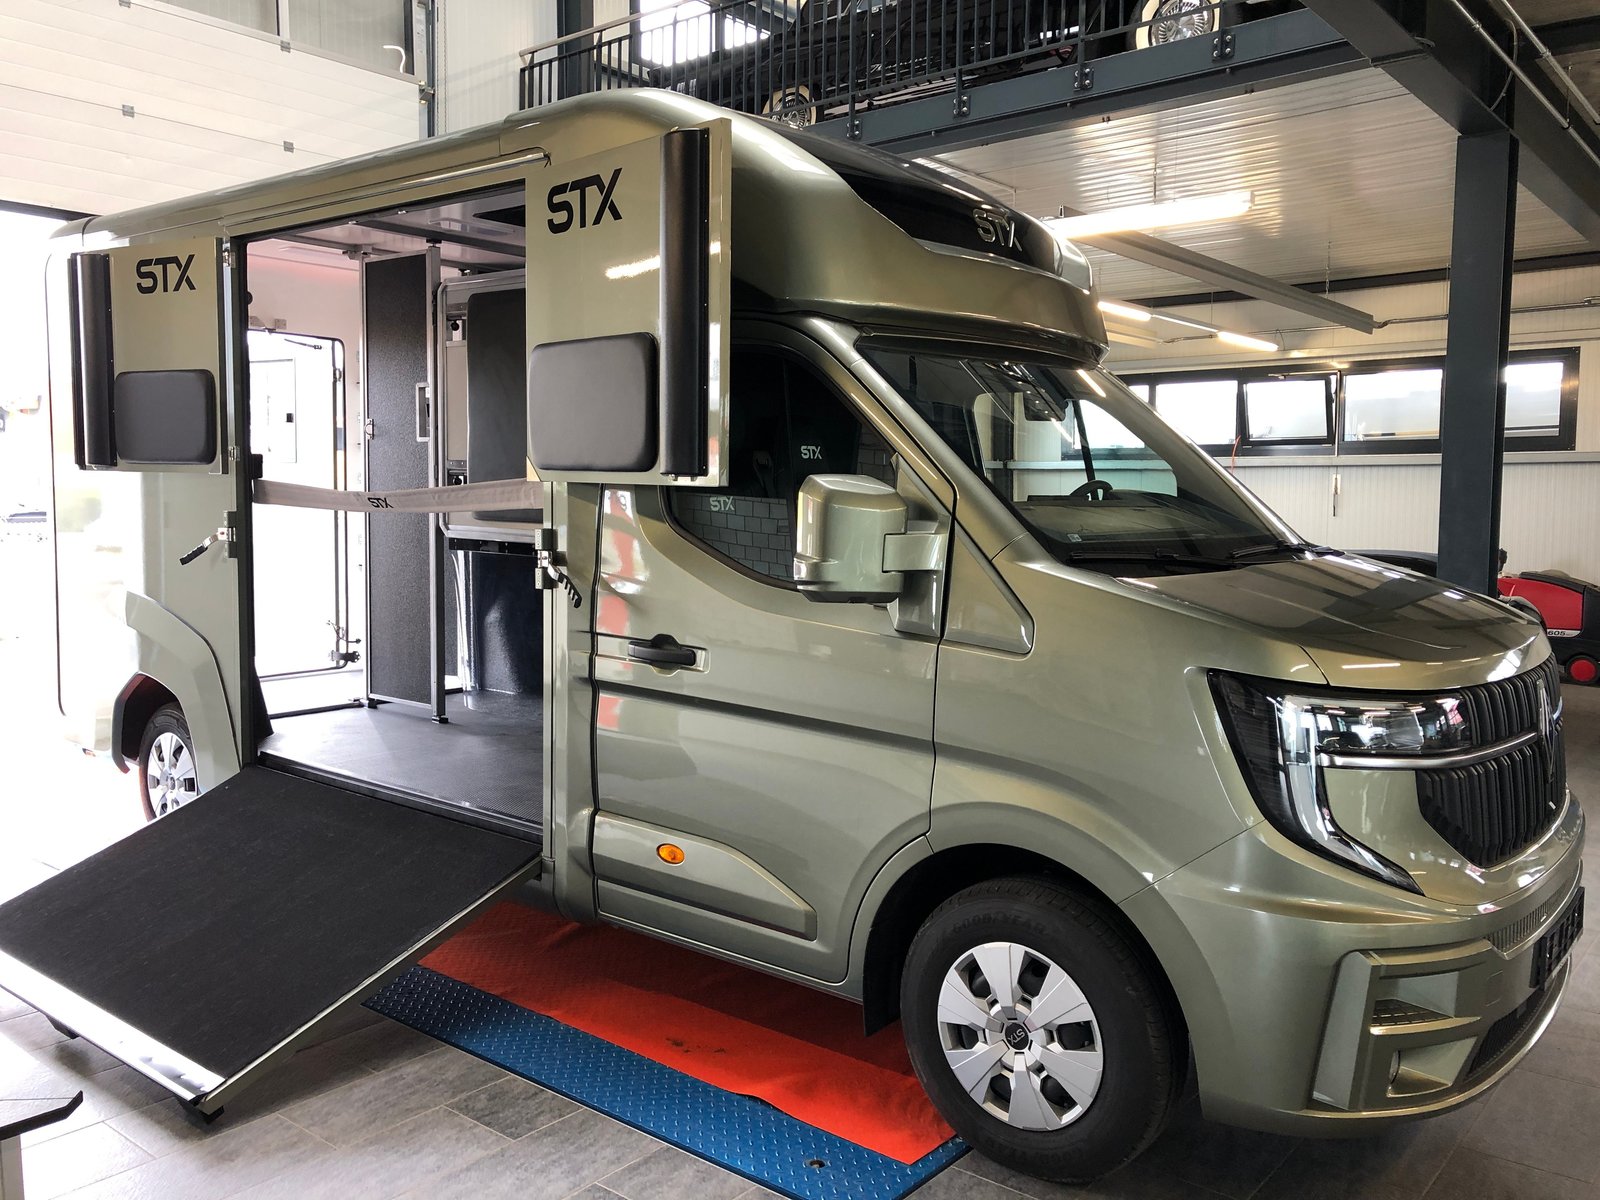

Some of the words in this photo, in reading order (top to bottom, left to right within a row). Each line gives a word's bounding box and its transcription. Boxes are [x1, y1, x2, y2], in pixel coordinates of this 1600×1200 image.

[547, 167, 623, 235] STX
[972, 208, 1023, 252] STX
[135, 253, 197, 295] STX
[800, 445, 823, 460] STX
[367, 497, 394, 509] STX
[709, 495, 736, 512] STX
[1007, 1028, 1026, 1046] STX
